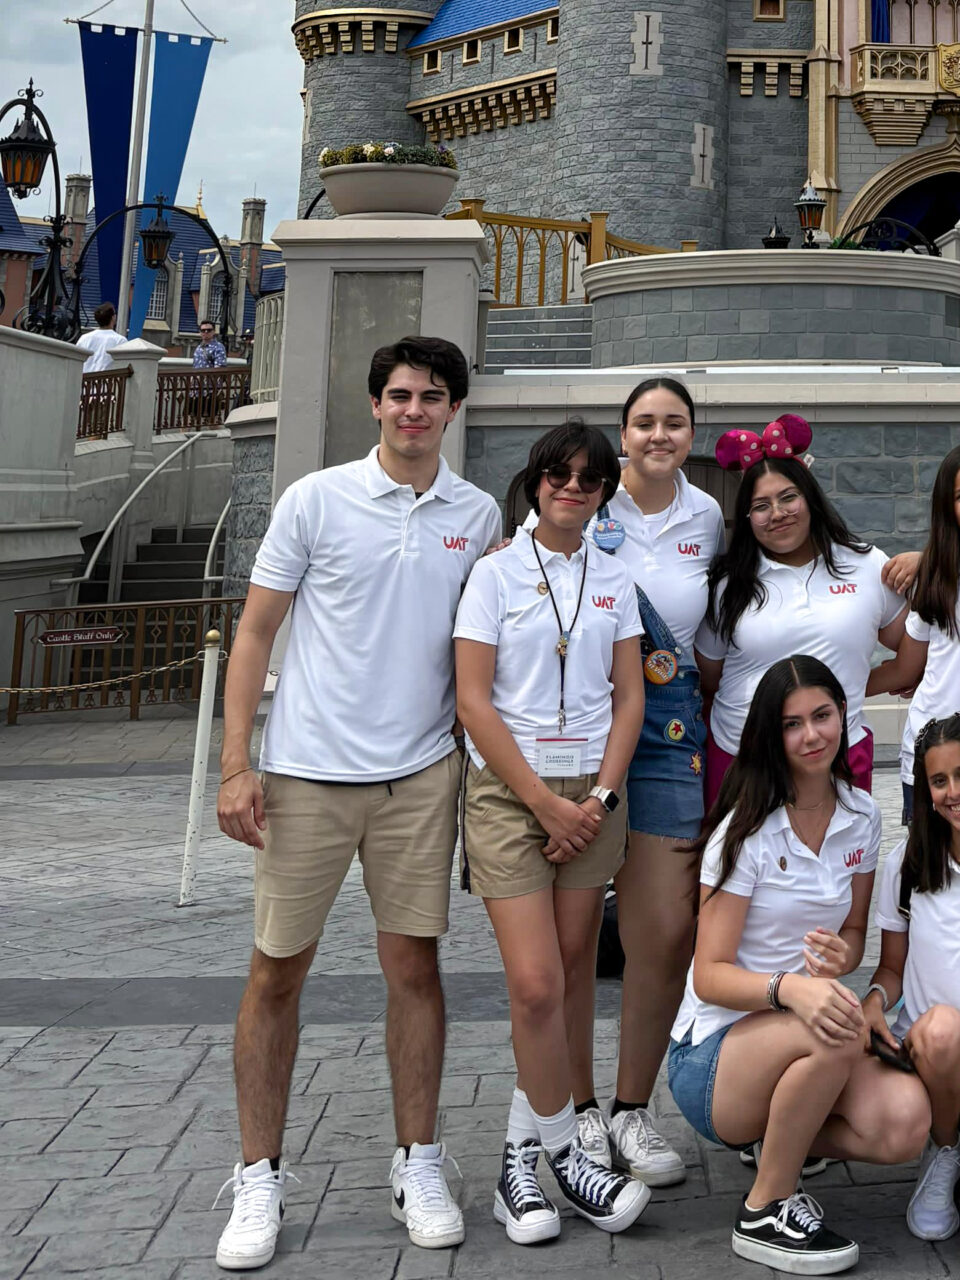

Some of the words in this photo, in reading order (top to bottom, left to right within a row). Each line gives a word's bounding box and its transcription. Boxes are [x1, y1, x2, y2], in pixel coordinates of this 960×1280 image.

[443, 536, 469, 551] UAT
[677, 543, 701, 557] UAT
[829, 583, 858, 595] UAT
[592, 595, 616, 610] UAT
[46, 634, 72, 642] Castle
[73, 632, 94, 641] Staff
[95, 631, 114, 640] Only
[843, 848, 865, 868] UAT
